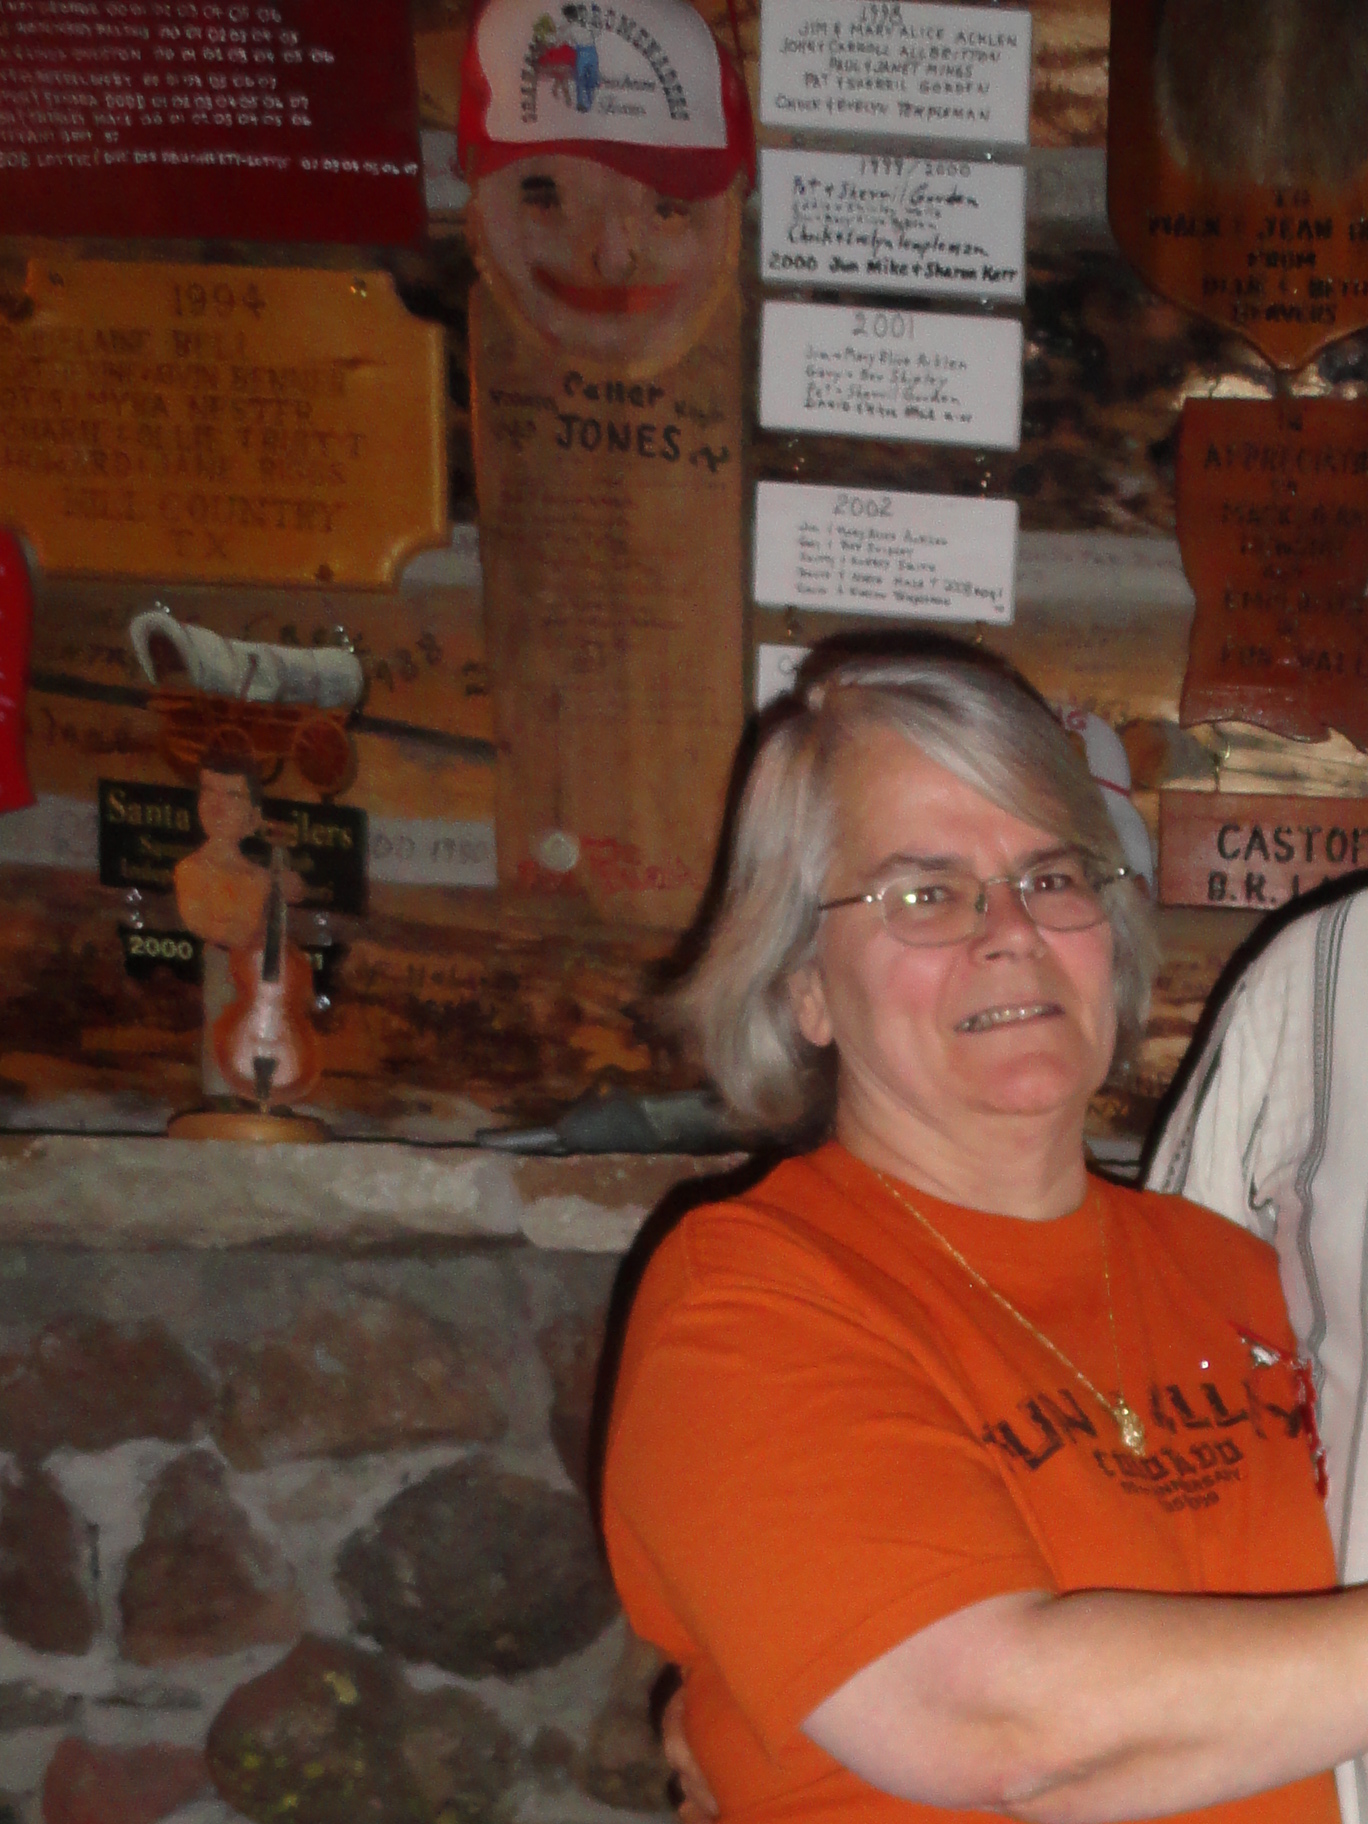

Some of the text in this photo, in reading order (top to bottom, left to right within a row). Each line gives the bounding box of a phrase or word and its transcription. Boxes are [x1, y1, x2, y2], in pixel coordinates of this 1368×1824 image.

[900, 24, 945, 40] ALICE
[769, 251, 819, 270] 2000
[853, 313, 916, 340] 2001
[556, 412, 683, 462] JONES
[833, 492, 894, 518] 2002
[106, 789, 191, 832] Santa
[129, 936, 195, 960] 2000
